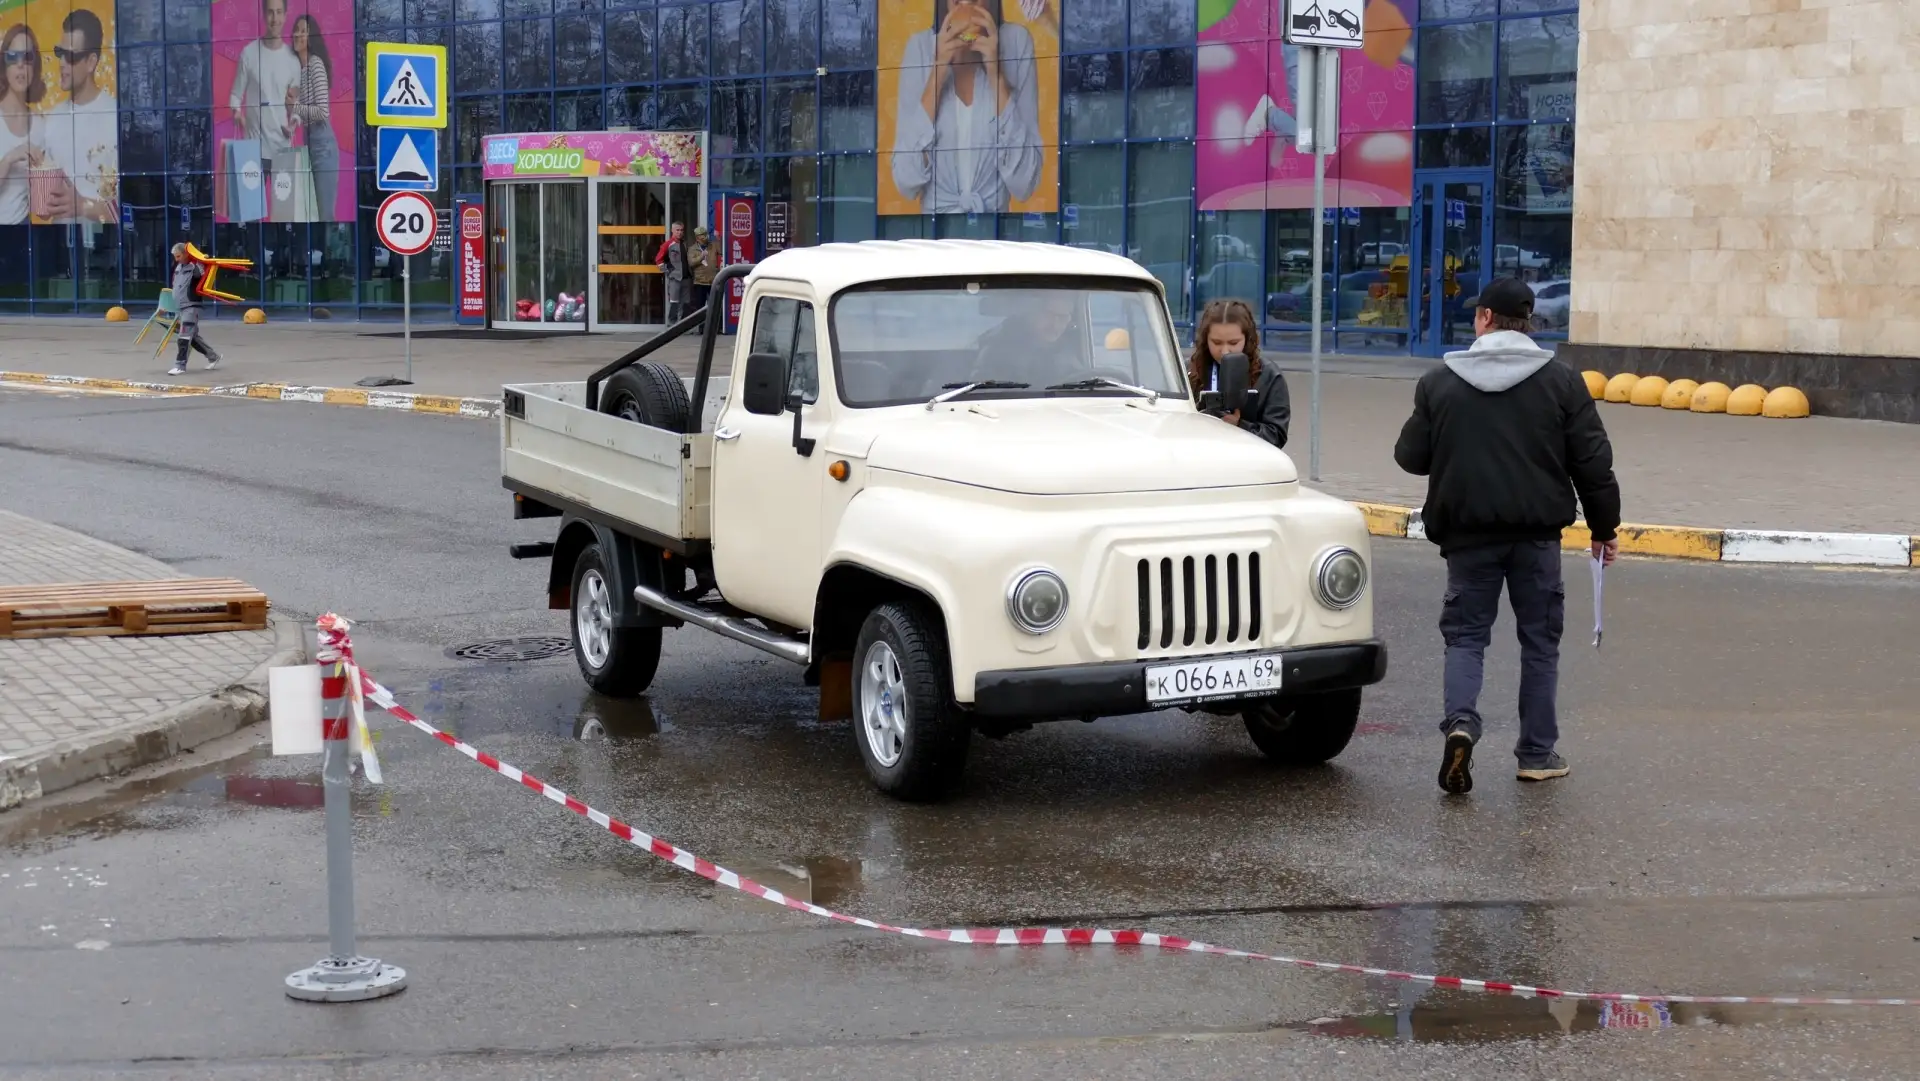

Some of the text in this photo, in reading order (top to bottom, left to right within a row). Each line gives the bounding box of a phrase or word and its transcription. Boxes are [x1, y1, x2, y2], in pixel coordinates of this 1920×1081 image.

[489, 142, 516, 162] ЗДЕСЬ
[517, 153, 580, 169] ХОРОШО
[390, 213, 424, 233] 20
[464, 223, 481, 231] KING
[732, 221, 751, 230] KING
[464, 242, 472, 292] БУРГЕР
[472, 256, 481, 292] КИНГ
[1255, 678, 1272, 687] RUS
